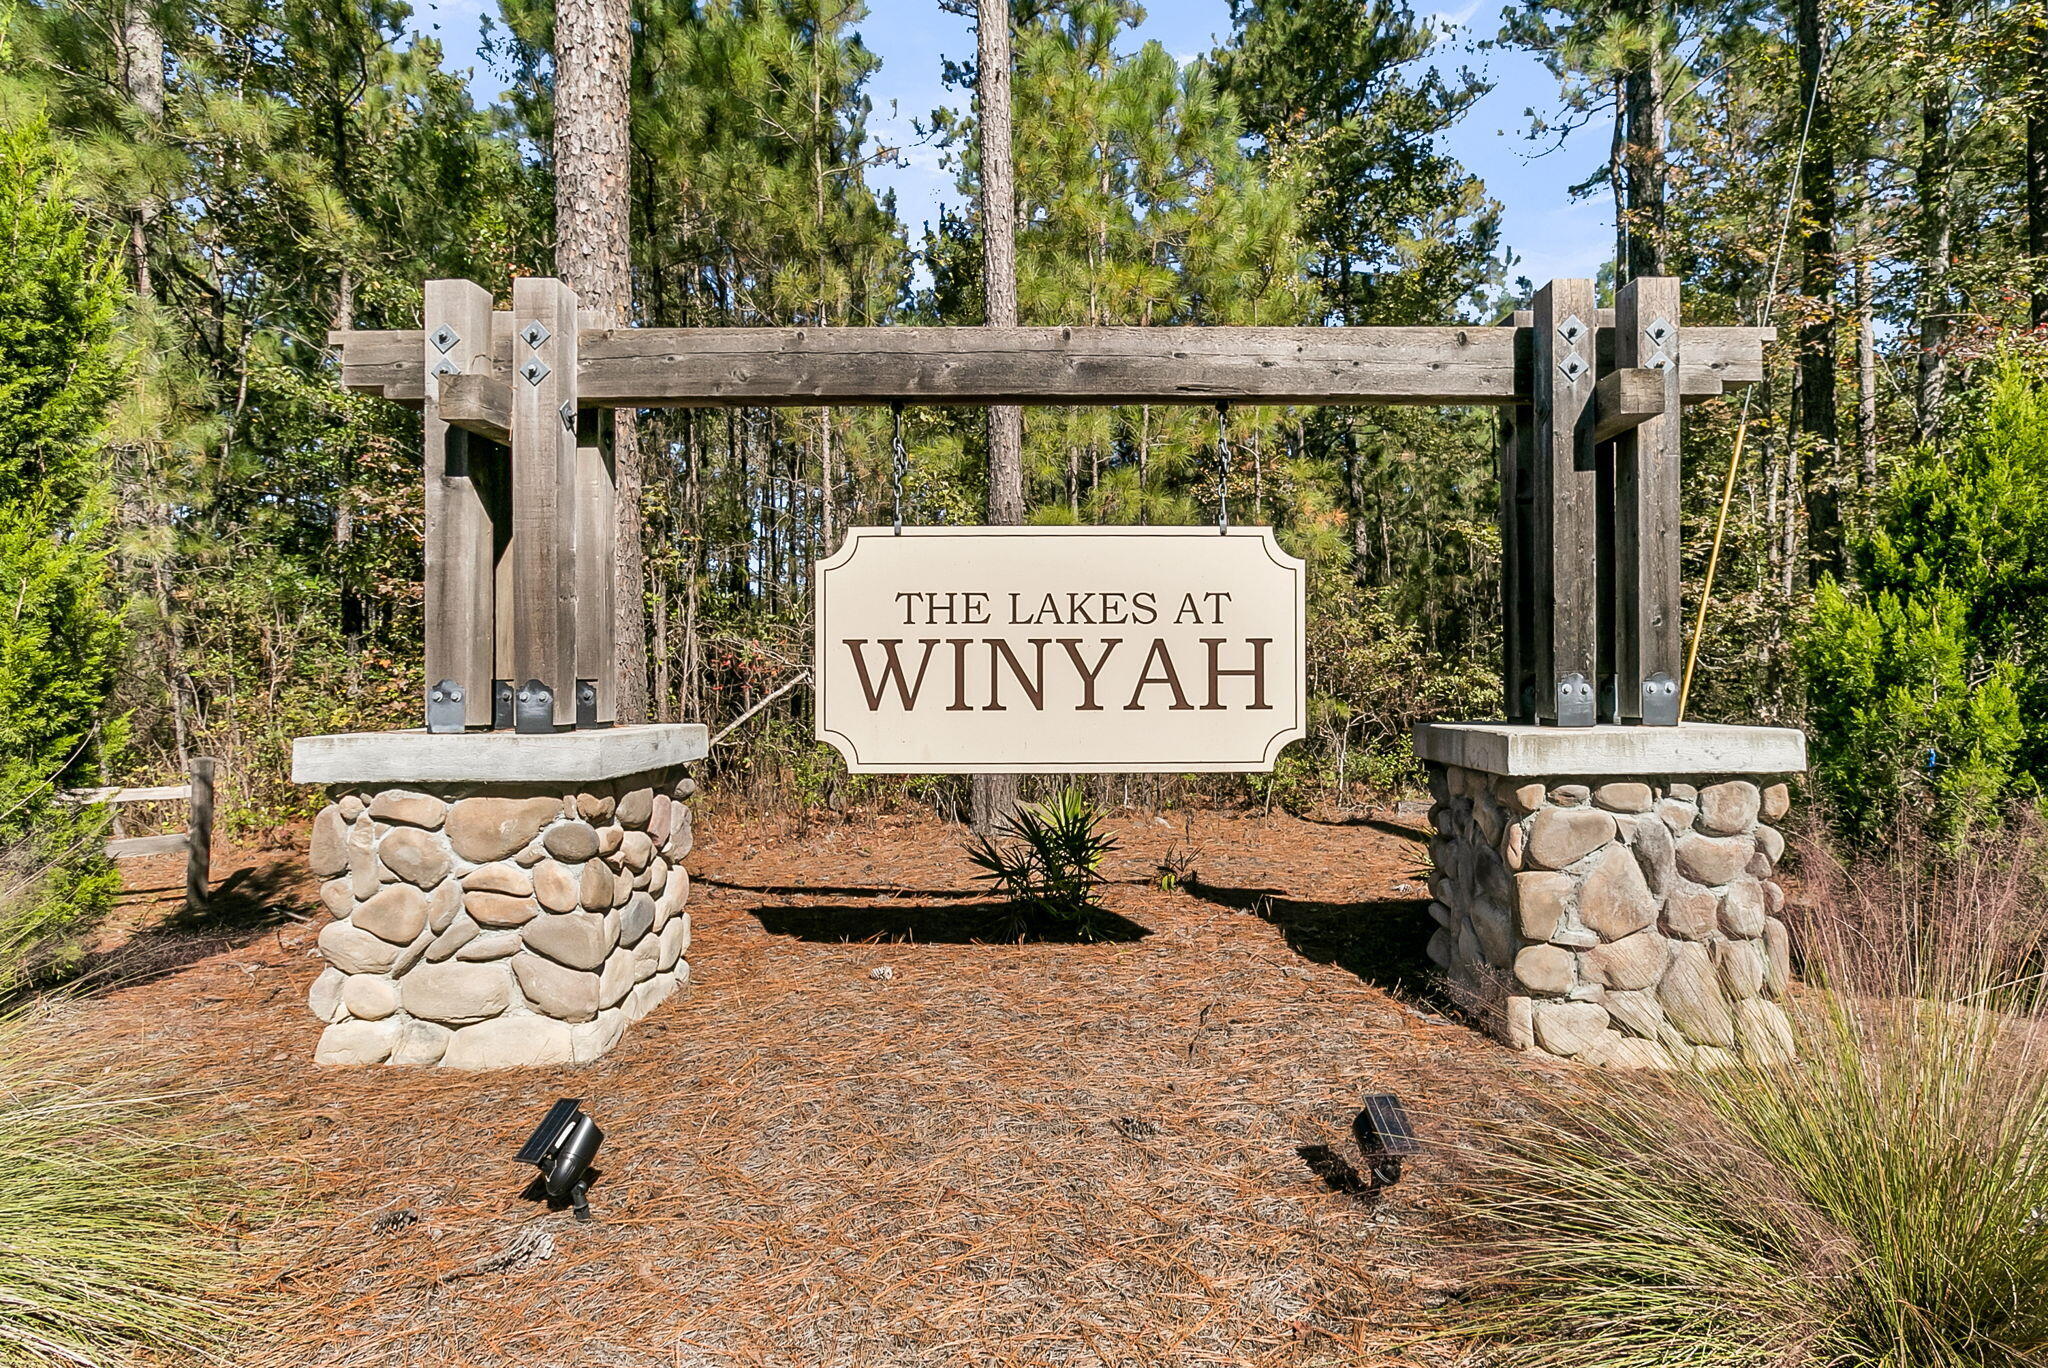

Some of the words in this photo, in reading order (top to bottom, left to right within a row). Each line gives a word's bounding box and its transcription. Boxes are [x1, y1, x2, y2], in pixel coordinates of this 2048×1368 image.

[894, 592, 991, 625] THE
[1008, 592, 1158, 625] LAKES
[1173, 592, 1232, 625] AT
[842, 638, 1273, 711] WINYAH
